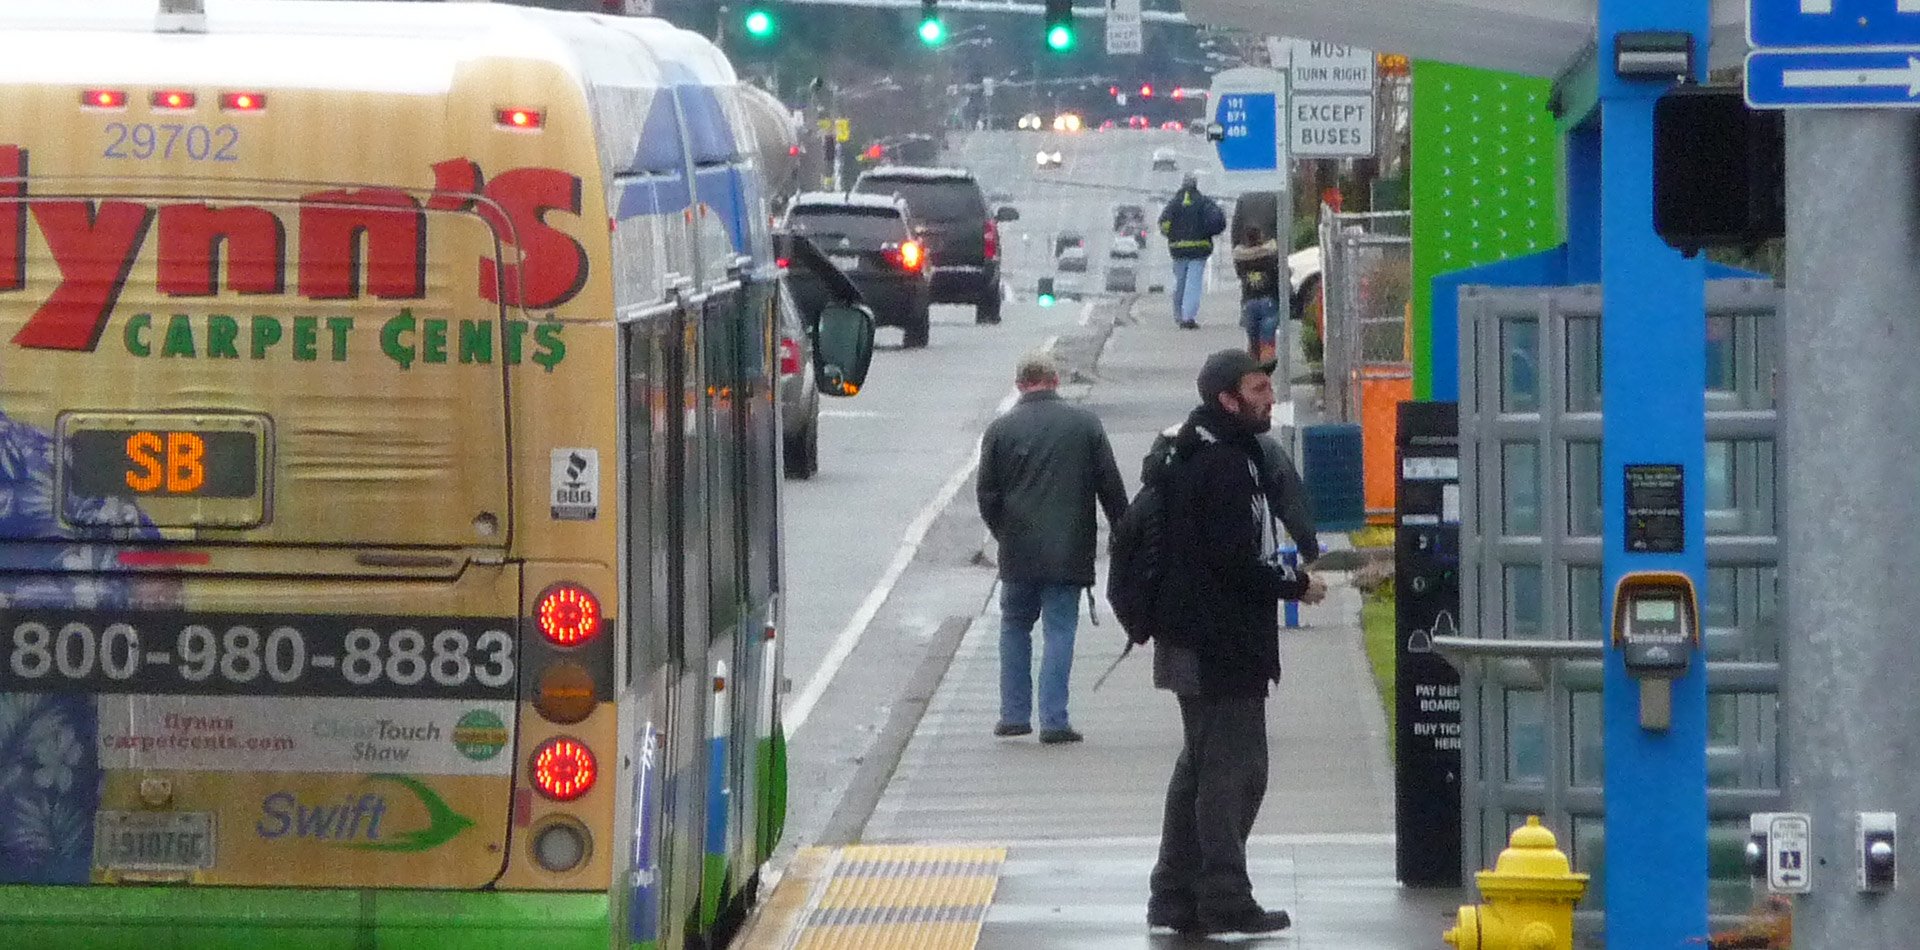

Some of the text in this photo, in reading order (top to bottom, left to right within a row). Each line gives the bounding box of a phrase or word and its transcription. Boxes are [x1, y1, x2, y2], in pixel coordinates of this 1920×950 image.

[1297, 67, 1367, 81] TURN RIGHT
[1298, 105, 1365, 121] EXCEPT
[103, 122, 240, 162] 29702
[1301, 128, 1361, 144] BUSES
[123, 312, 354, 361] CARPET
[125, 432, 205, 492] SB
[10, 621, 515, 687] 800-980-8883
[1415, 684, 1436, 697] PAY
[1414, 722, 1437, 735] BUY
[352, 742, 410, 762] Shaw
[256, 791, 387, 839] Swift
